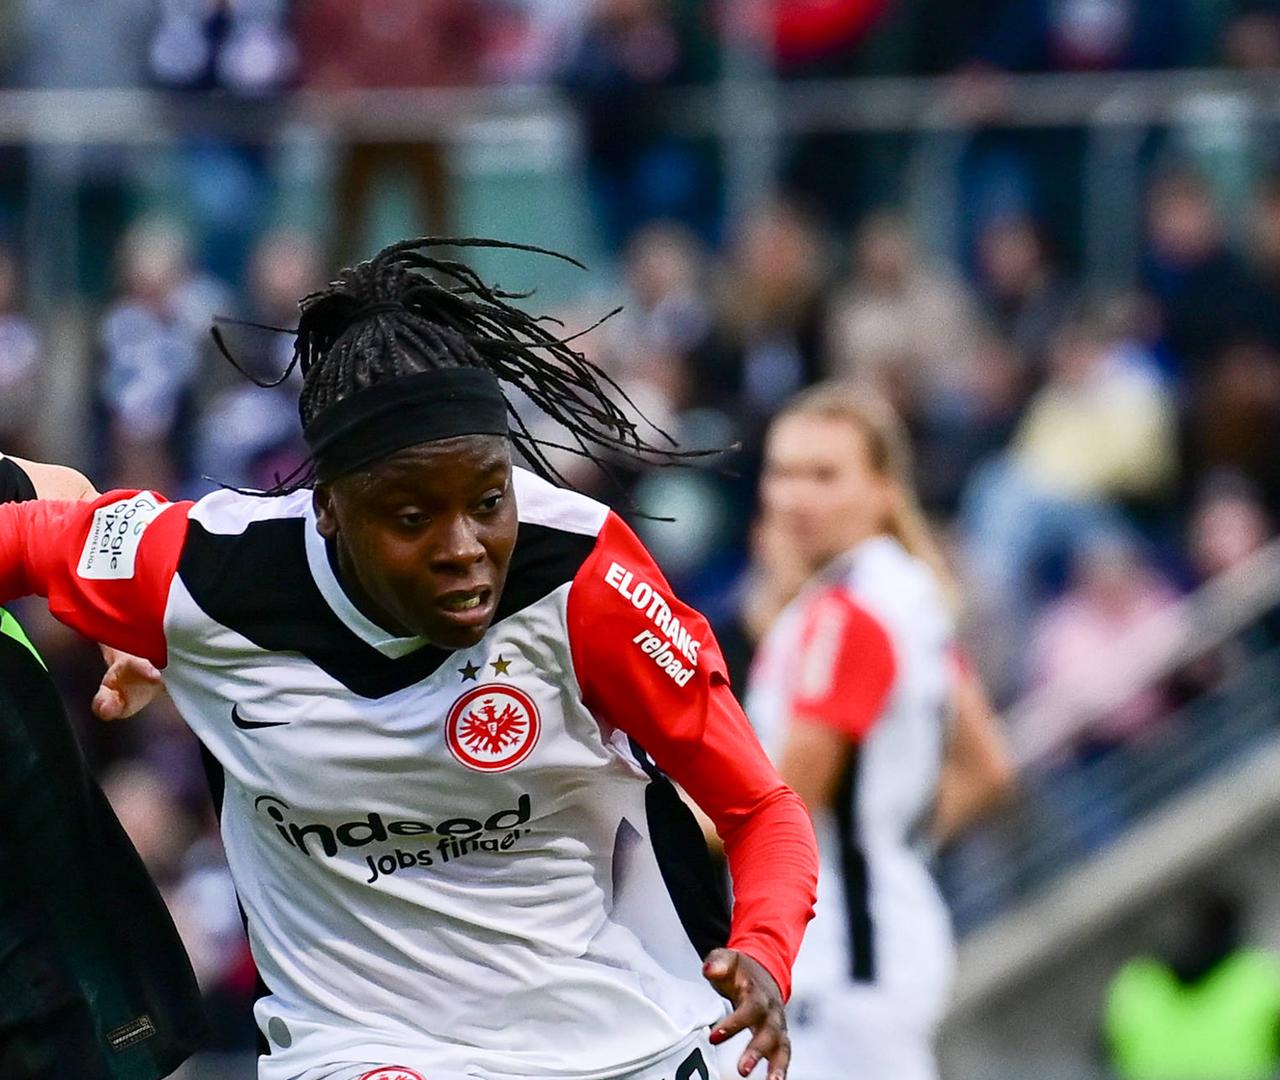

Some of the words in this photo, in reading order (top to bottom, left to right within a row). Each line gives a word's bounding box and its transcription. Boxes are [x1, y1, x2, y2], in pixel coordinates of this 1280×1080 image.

[604, 561, 701, 666] ELOTRANS
[632, 629, 696, 687] reload
[254, 793, 531, 858] indeed
[366, 849, 433, 884] Jobs
